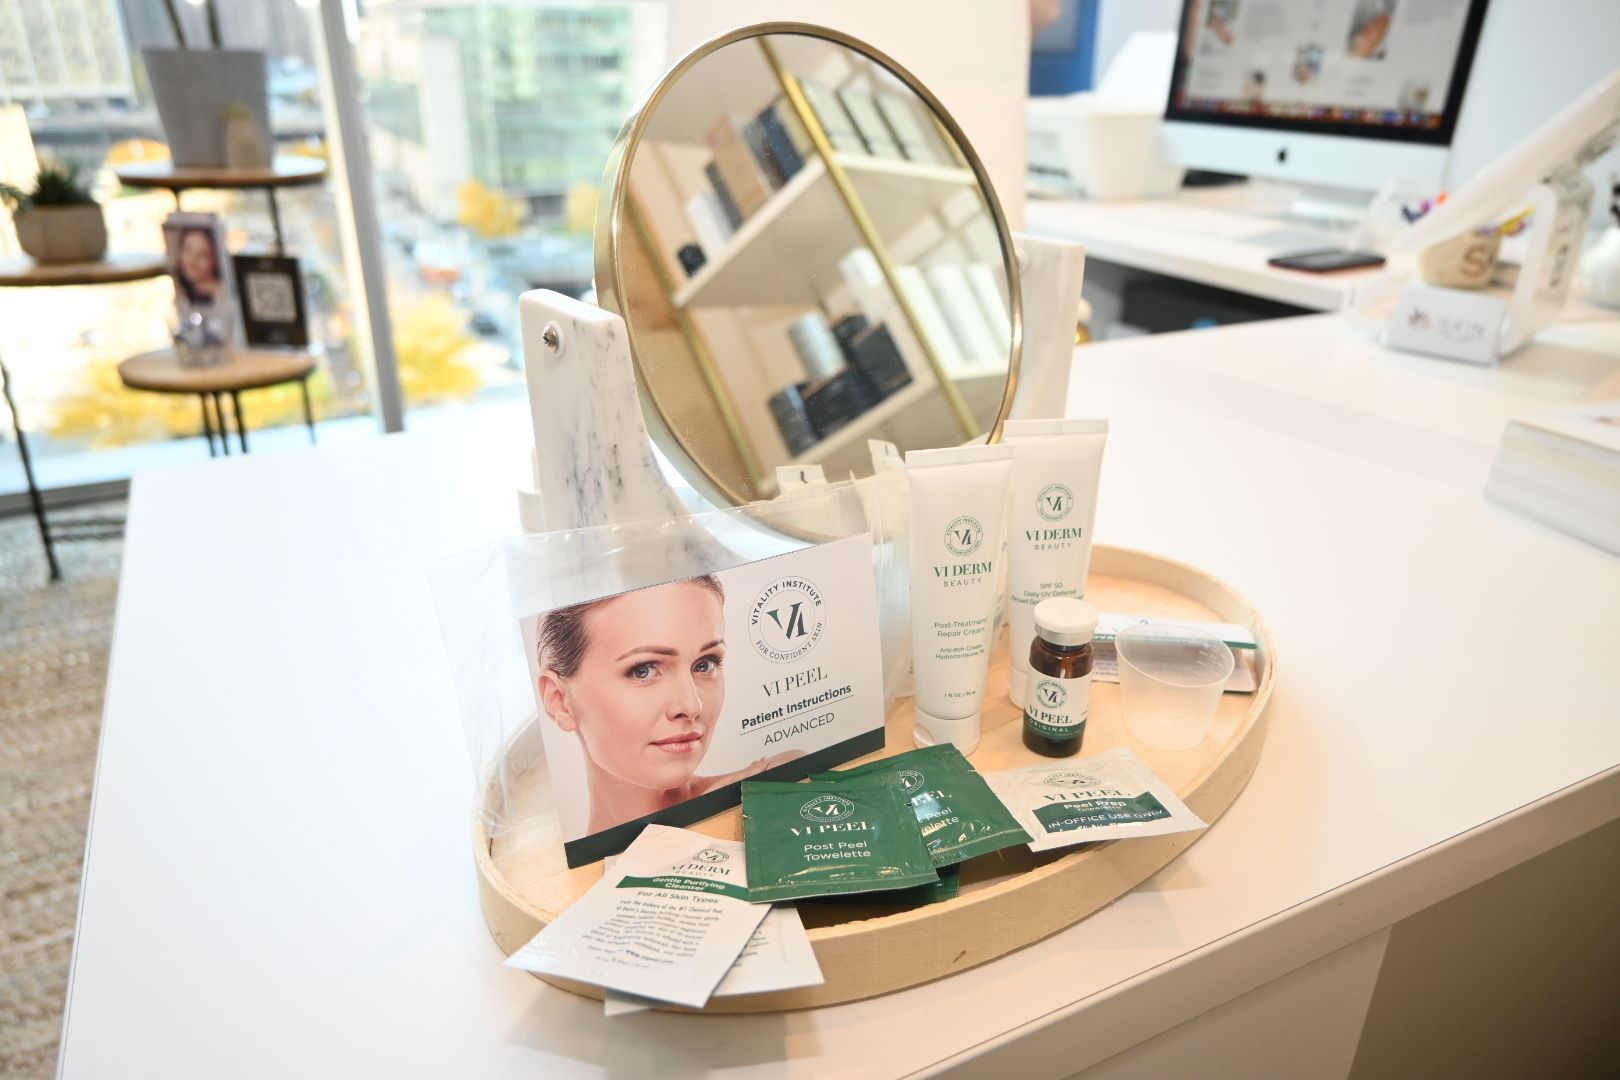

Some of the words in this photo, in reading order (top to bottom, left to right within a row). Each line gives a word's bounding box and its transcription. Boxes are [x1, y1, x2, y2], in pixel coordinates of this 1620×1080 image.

[1025, 530, 1039, 541] VI
[1044, 527, 1082, 541] DERM
[1034, 542, 1072, 551] BEAUTY
[933, 566, 949, 578] VI
[953, 561, 992, 577] DERM
[943, 578, 982, 588] BEAUTY
[751, 583, 779, 626] VITALITY
[782, 580, 822, 607] INSTITUTE
[934, 617, 988, 629] Post-Treatment
[937, 630, 961, 638] Repair
[963, 627, 985, 636] Cream
[756, 640, 769, 655] FOR
[769, 641, 812, 660] CONFIDENT
[812, 622, 823, 642] SKIN
[762, 680, 781, 698] VI
[784, 666, 828, 692] PEEL
[741, 707, 784, 730] Patient
[786, 684, 852, 714] Instructions
[1029, 704, 1039, 718] VI
[1041, 711, 1073, 724] PEEL
[764, 712, 835, 746] ADVANCED
[1029, 718, 1069, 733] ORIGINAL
[1072, 789, 1132, 799] PEEL
[1063, 802, 1093, 810] Peel
[1095, 800, 1127, 808] Prep
[1048, 814, 1107, 829] IN-OFFICE
[1133, 809, 1163, 818] ONLY
[790, 825, 811, 836] VI
[819, 821, 876, 833] PEEL
[804, 843, 835, 852] Post
[838, 840, 867, 849] Peel
[804, 850, 871, 862] Towelette
[687, 864, 731, 876] DERM
[664, 882, 706, 891] Cleanser
[684, 878, 726, 890] Purifying
[669, 892, 689, 900] Skin
[693, 895, 719, 903] Types
